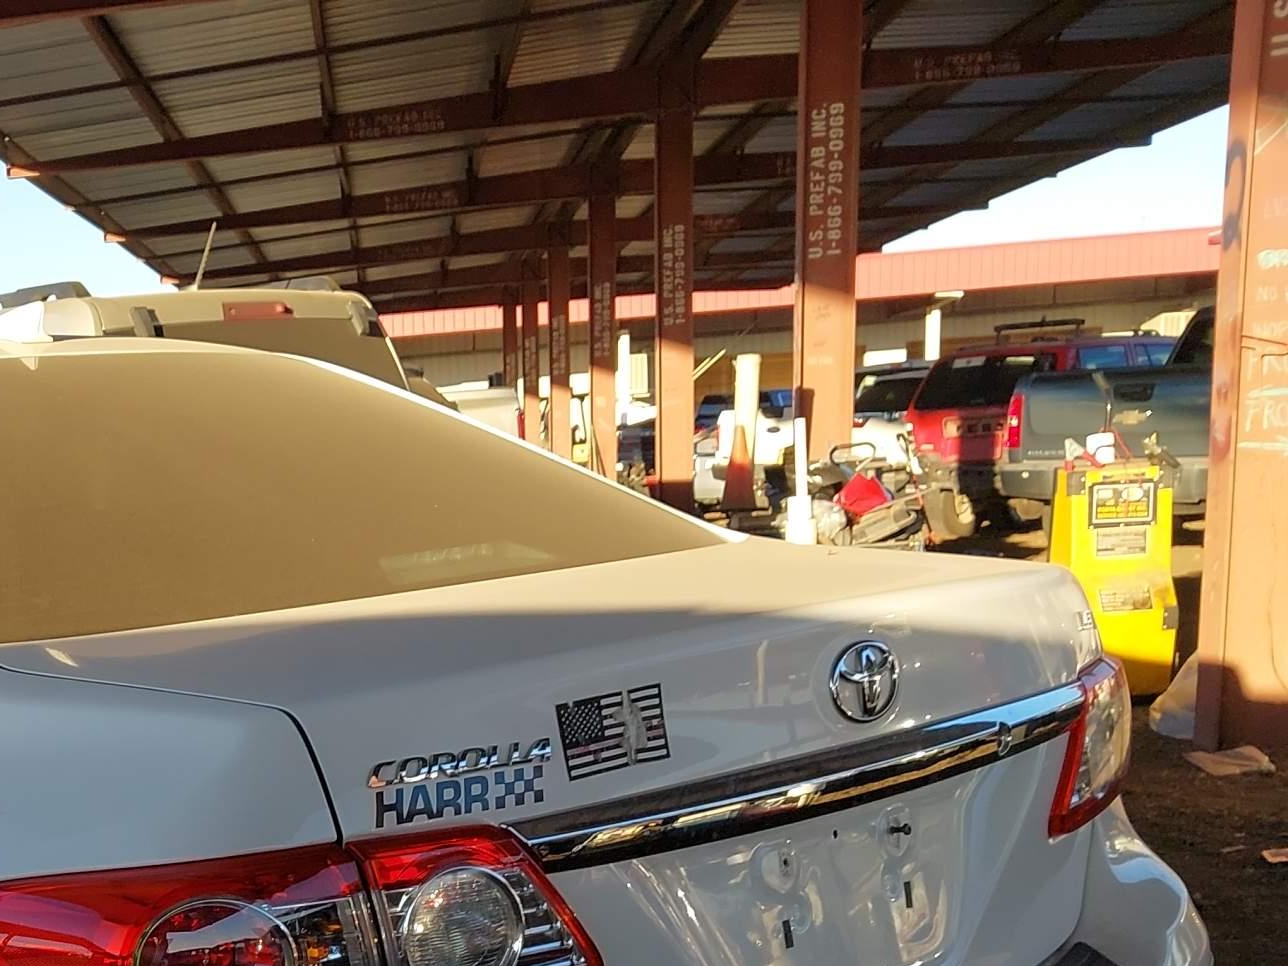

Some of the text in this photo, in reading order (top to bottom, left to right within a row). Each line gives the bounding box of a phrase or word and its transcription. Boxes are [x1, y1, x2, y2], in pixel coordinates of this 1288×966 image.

[808, 103, 827, 259] U.S. PREFAB INC.
[826, 102, 845, 256] 1-866-799-0969
[367, 737, 552, 789] COROLLA
[375, 776, 490, 829] HARR
